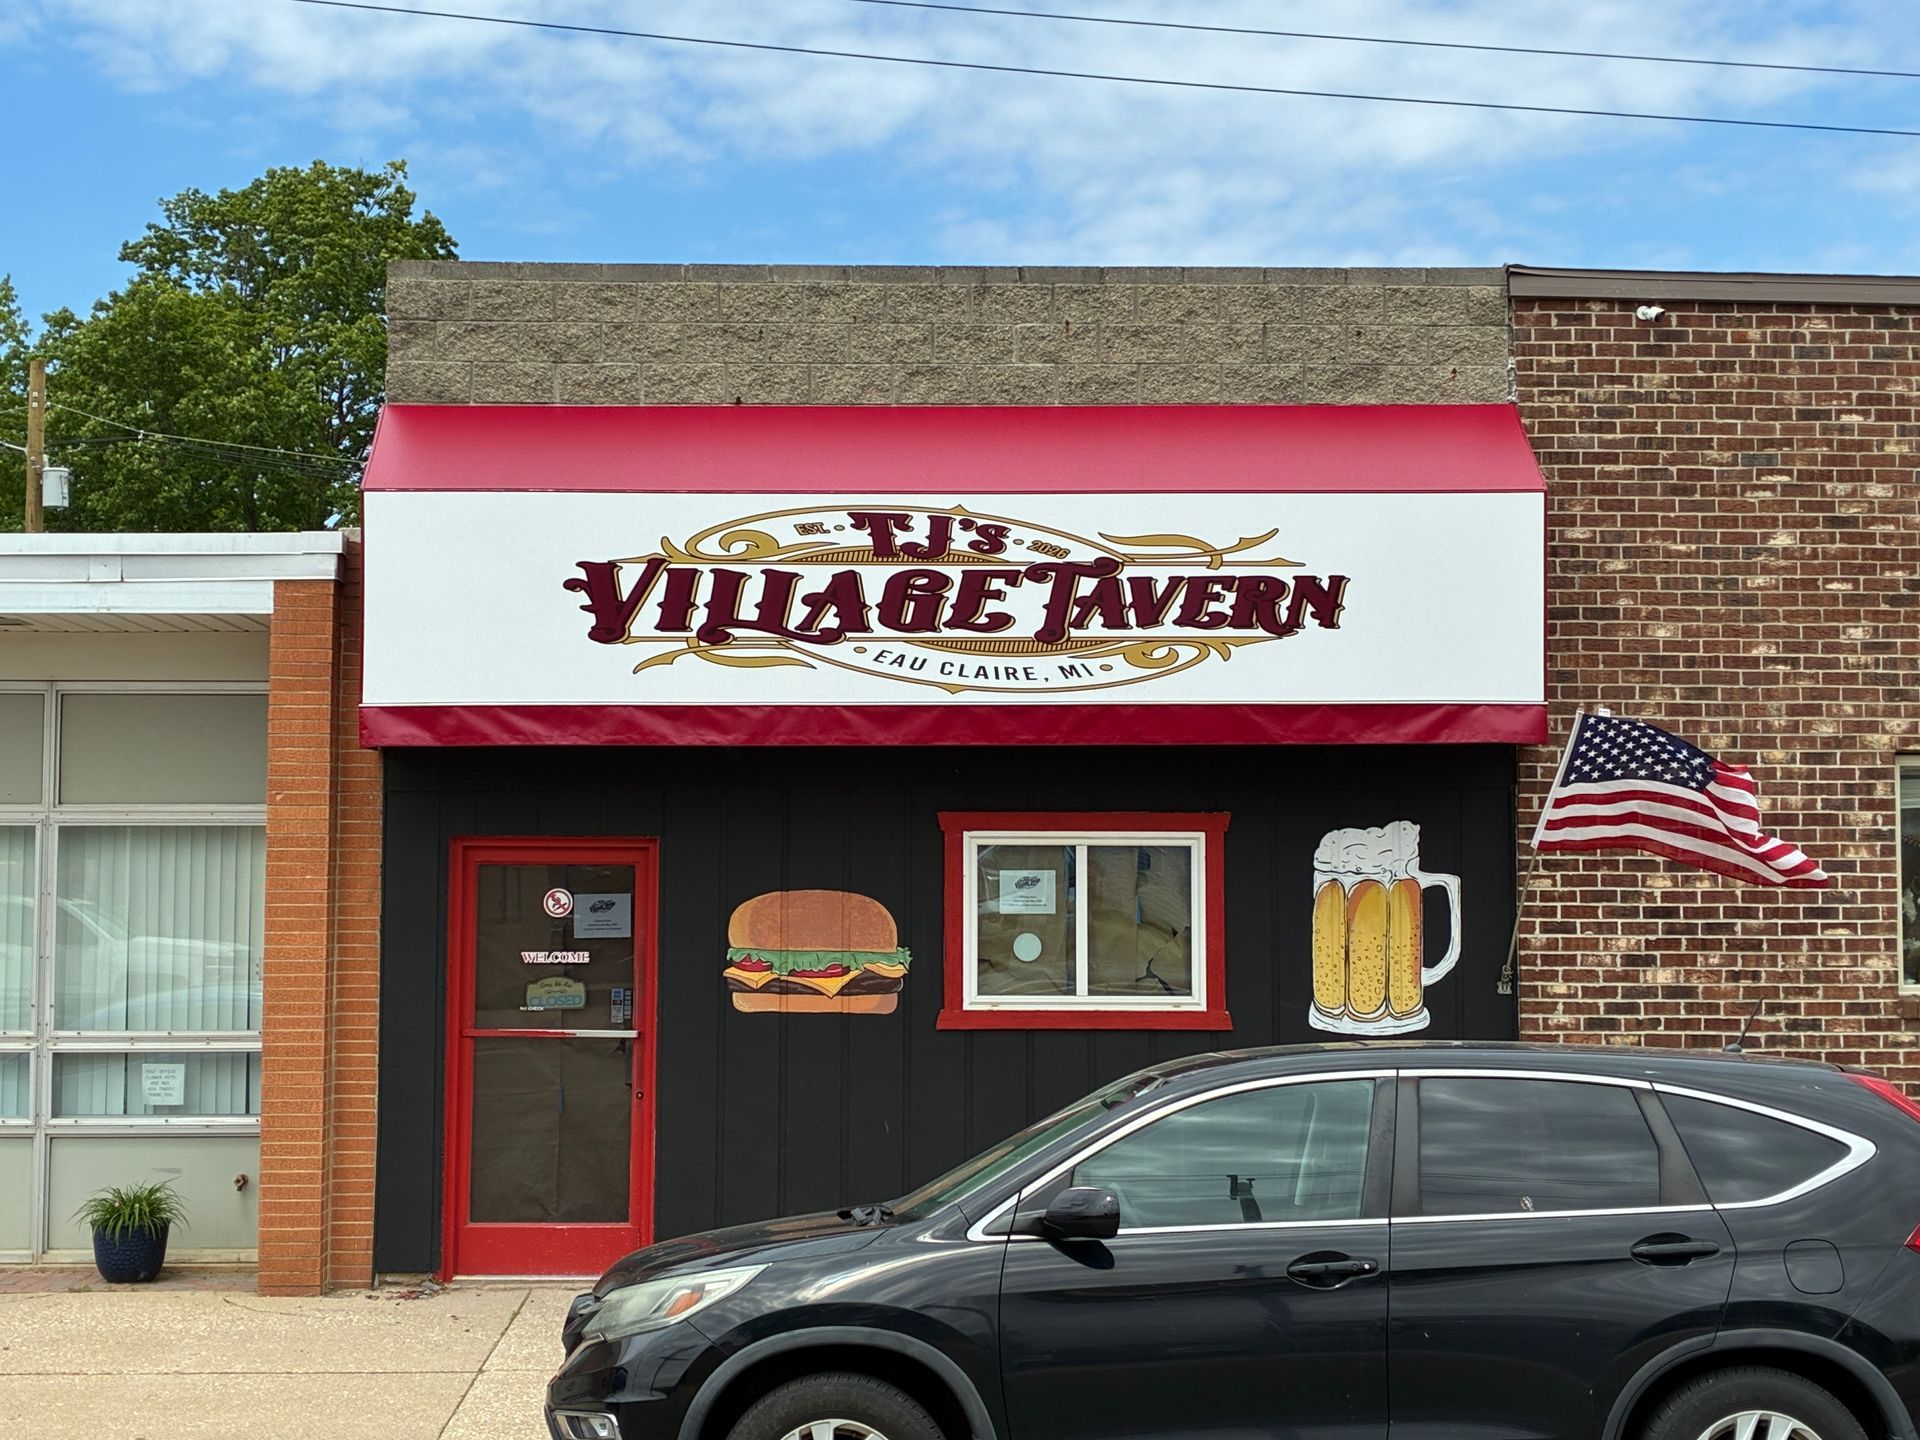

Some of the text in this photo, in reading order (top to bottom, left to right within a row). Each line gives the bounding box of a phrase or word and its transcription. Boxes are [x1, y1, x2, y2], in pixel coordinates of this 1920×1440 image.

[794, 522, 831, 536] EST.
[1026, 539, 1072, 560] 2026
[562, 556, 1351, 645] VILLAGE TAVERN
[872, 649, 1095, 683] EAU CLAIRE, MI
[521, 951, 590, 964] WELCOME
